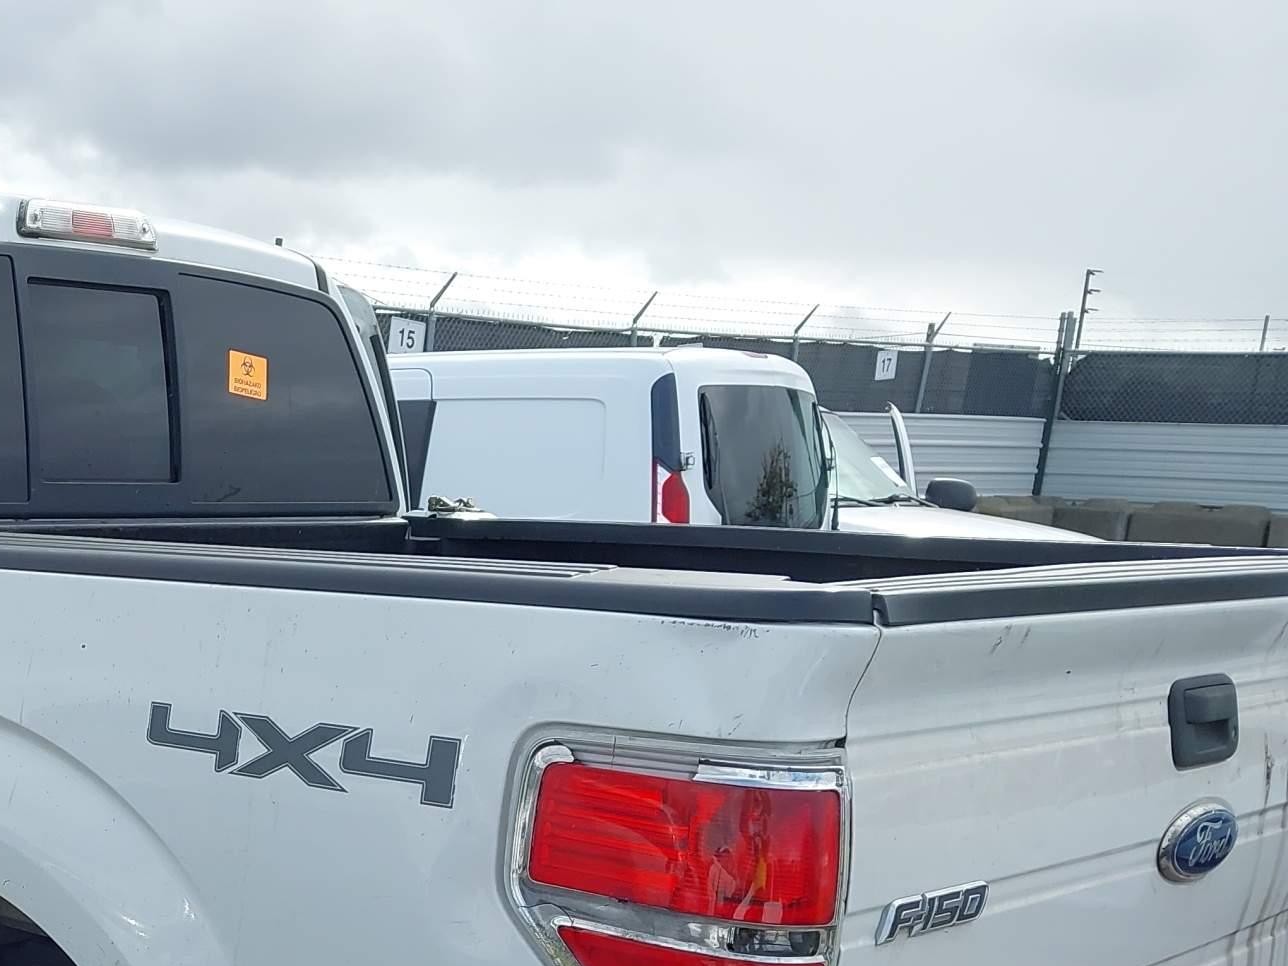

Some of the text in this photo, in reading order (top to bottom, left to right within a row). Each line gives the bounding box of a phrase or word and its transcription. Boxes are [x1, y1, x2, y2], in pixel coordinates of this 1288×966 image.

[398, 327, 416, 349] 15
[881, 357, 893, 374] 17
[146, 701, 462, 809] 4X4
[1187, 820, 1232, 868] Ford
